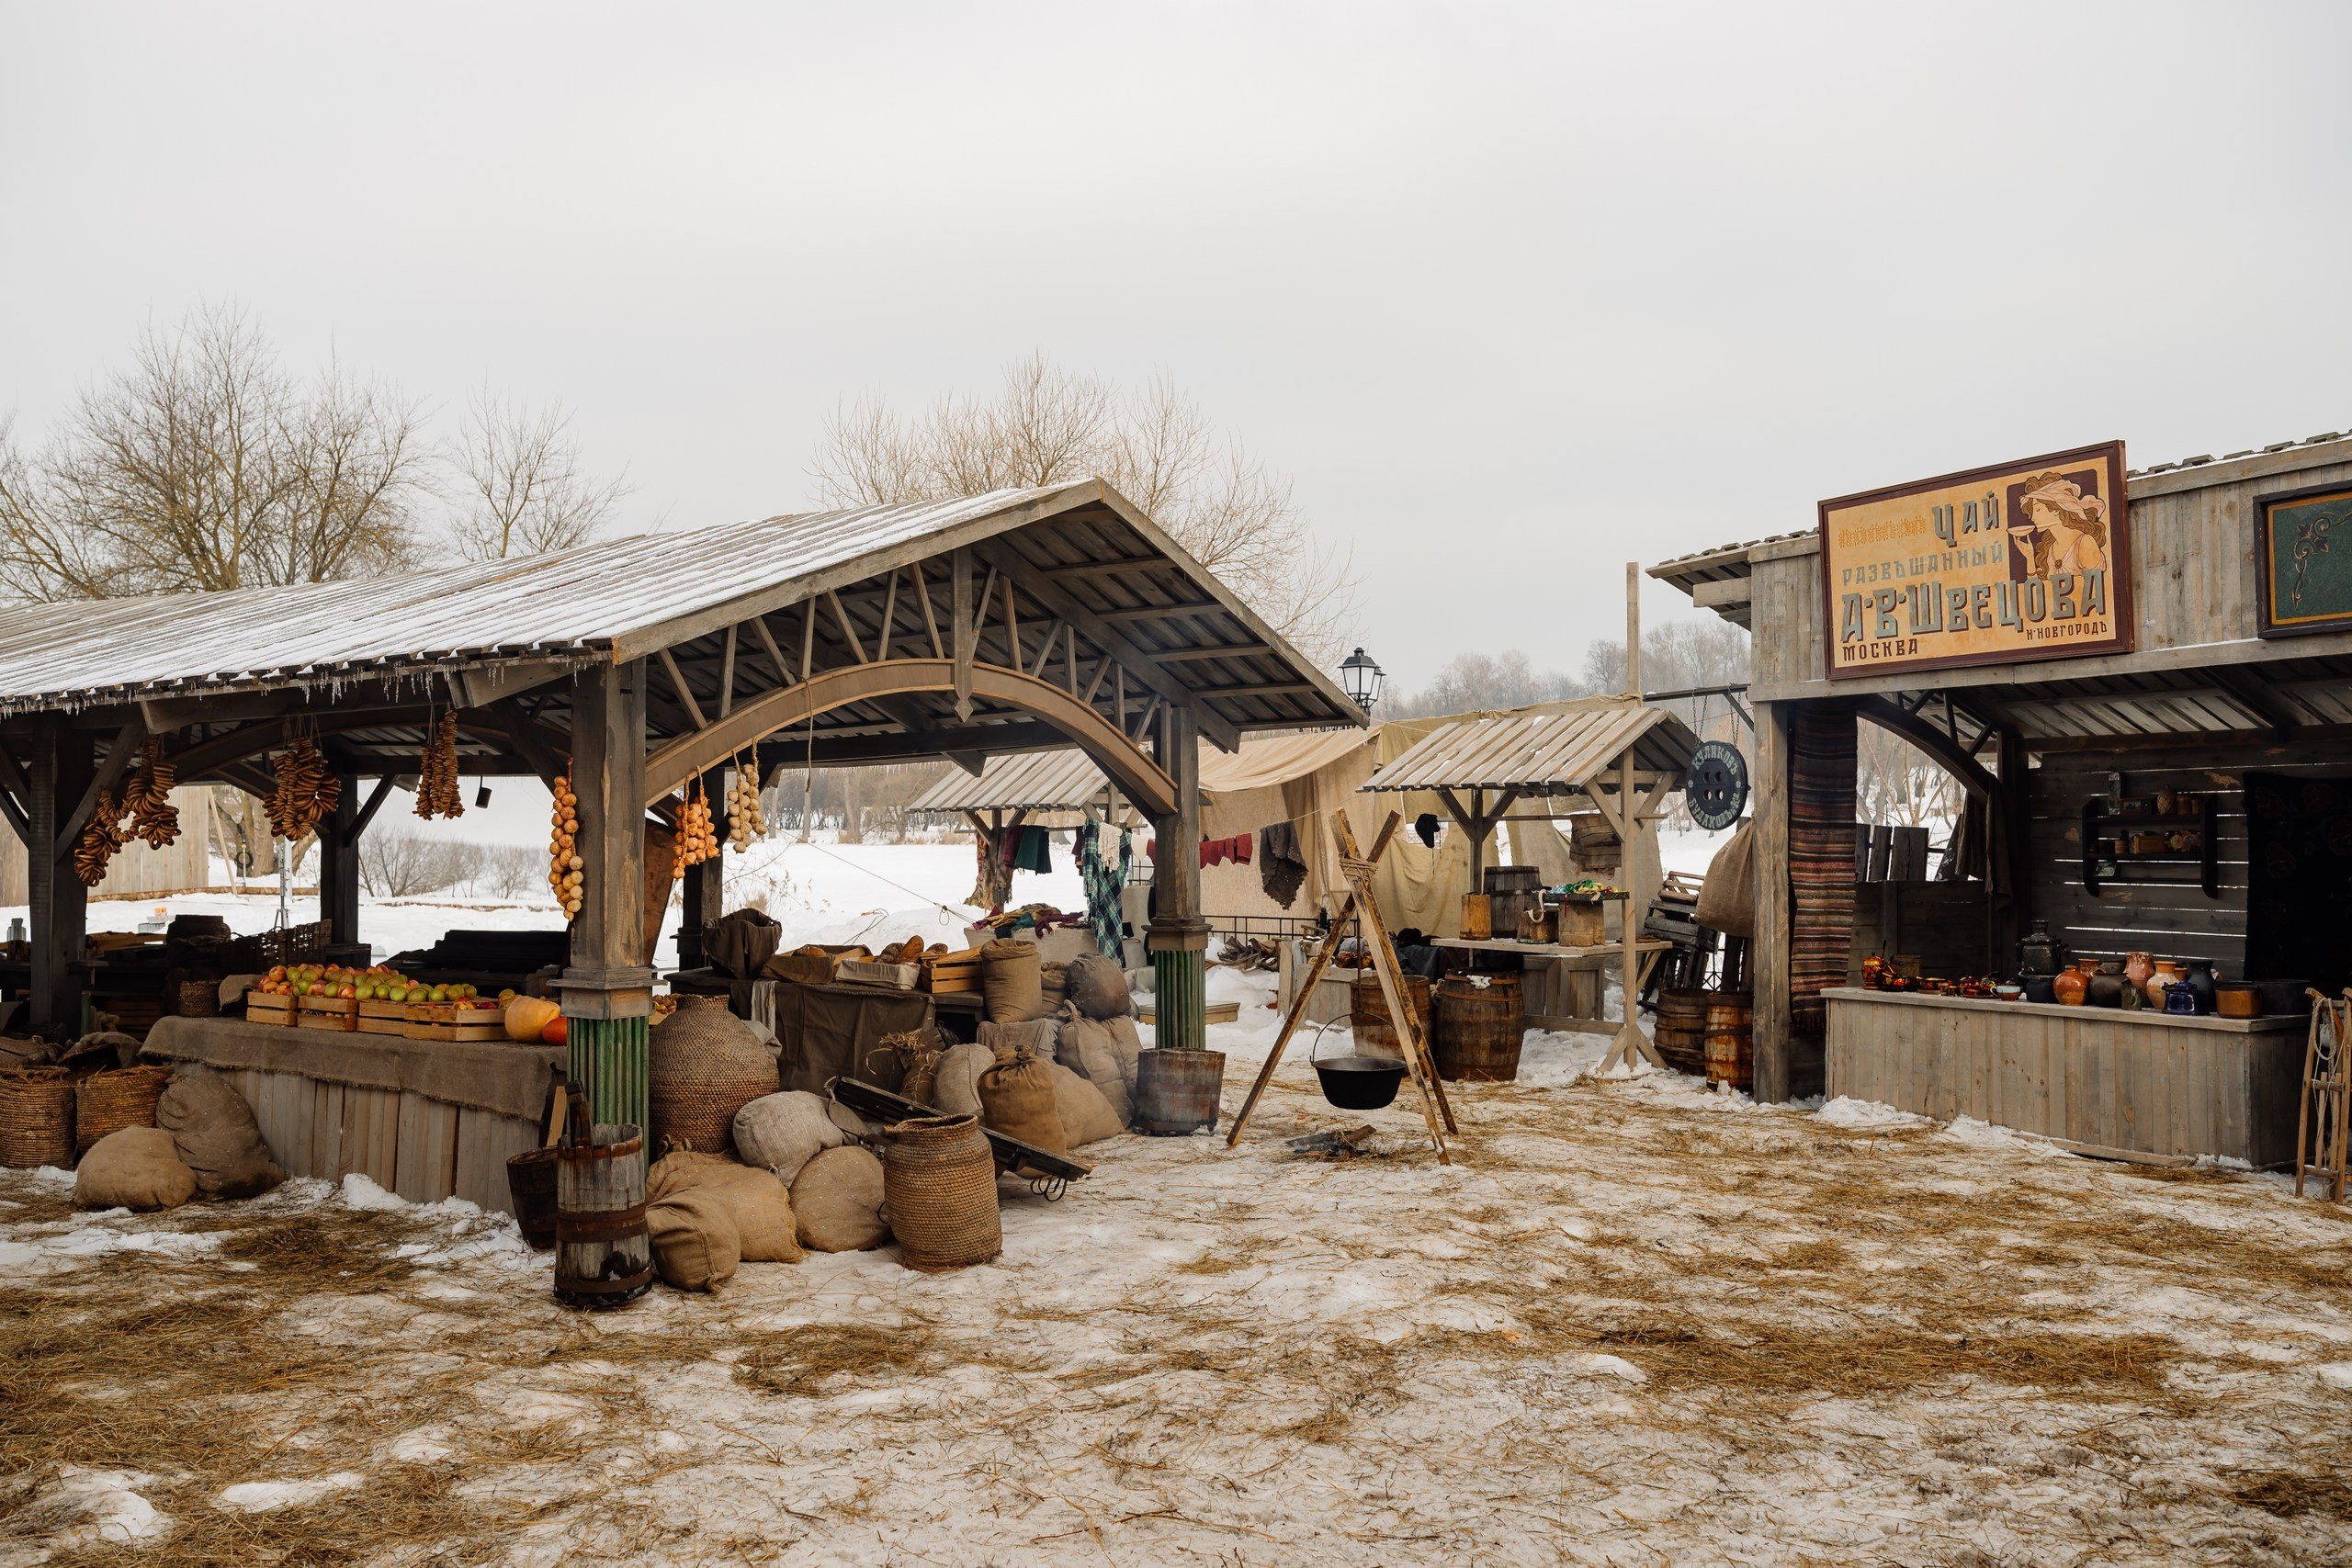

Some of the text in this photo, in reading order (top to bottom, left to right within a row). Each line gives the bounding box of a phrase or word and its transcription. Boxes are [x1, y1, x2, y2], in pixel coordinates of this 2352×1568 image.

[1931, 490, 1999, 548] ЧАЙ
[1842, 638, 1918, 661] МОСКВА
[1690, 744, 1738, 775] КУЛИКОВЪ
